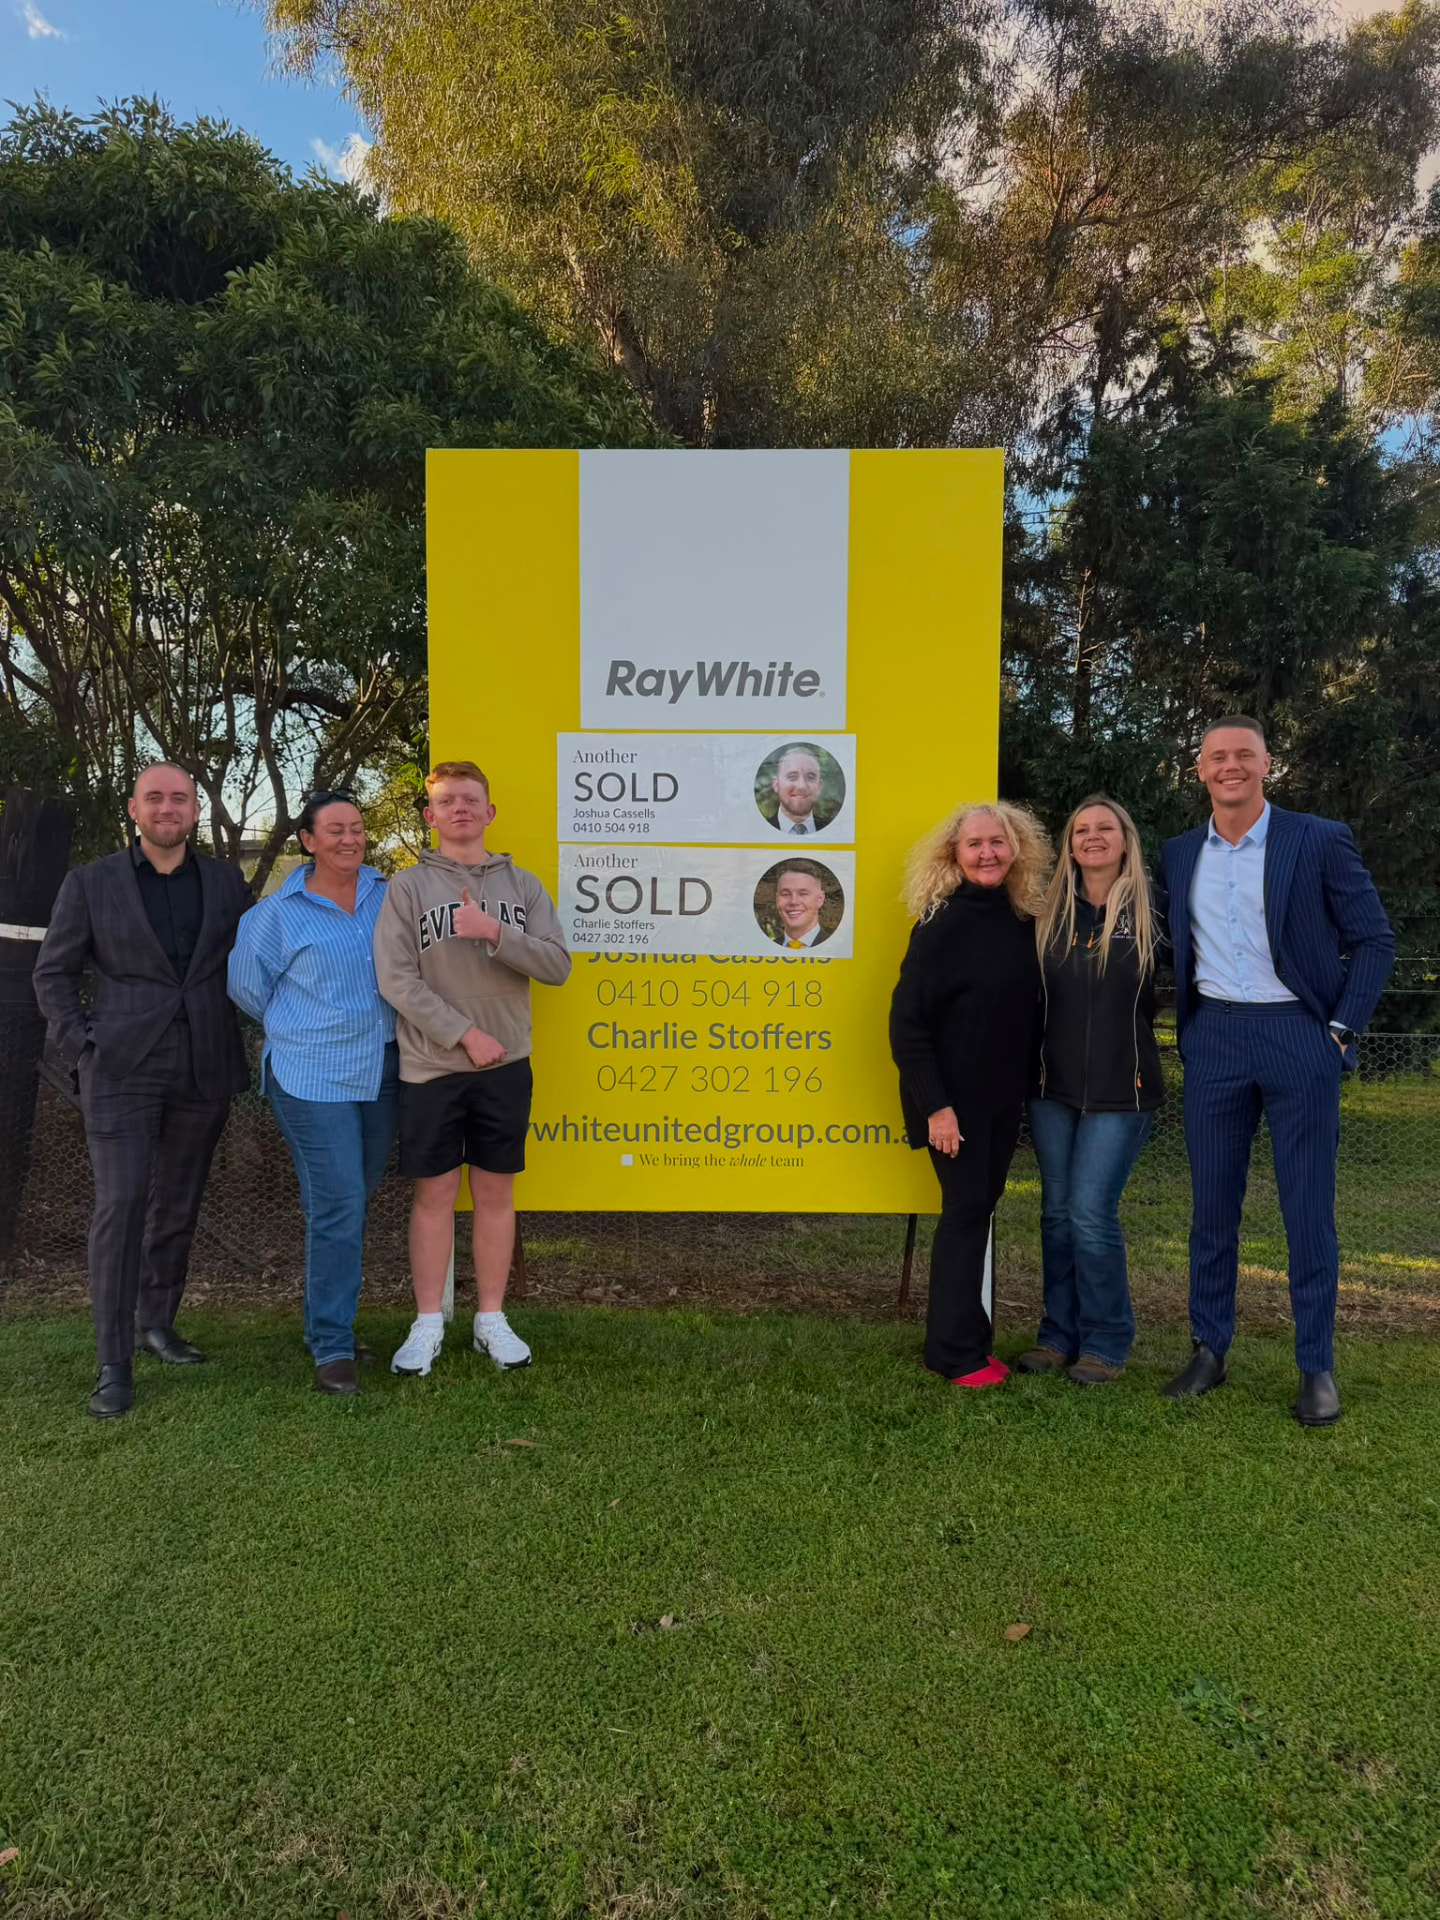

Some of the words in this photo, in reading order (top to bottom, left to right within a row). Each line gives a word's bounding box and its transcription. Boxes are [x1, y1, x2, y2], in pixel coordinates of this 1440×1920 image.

[573, 749, 638, 763] Another
[574, 772, 679, 802] SOLD
[573, 808, 610, 819] Joshua
[613, 808, 655, 819] Cassells
[573, 823, 601, 833] 0410
[604, 823, 625, 833] 504
[628, 823, 650, 833] 918
[574, 854, 638, 868] Another
[575, 875, 713, 916] SOLD
[573, 918, 610, 929] Charlie
[613, 919, 655, 930] Stoffers
[573, 933, 600, 943] 0427
[603, 933, 625, 943] 302
[628, 934, 649, 944] 196
[597, 979, 679, 1007] 0410
[691, 980, 750, 1007] 504
[763, 980, 823, 1007] 918
[587, 1022, 698, 1049] Charlie
[708, 1022, 832, 1050] Stoffers
[597, 1065, 678, 1092] 0427
[691, 1066, 750, 1092] 302
[764, 1066, 823, 1093] 196
[639, 1154, 659, 1166] We
[664, 1153, 700, 1168] bring
[704, 1154, 726, 1166] the
[729, 1154, 767, 1167] whole
[770, 1156, 804, 1167] team
